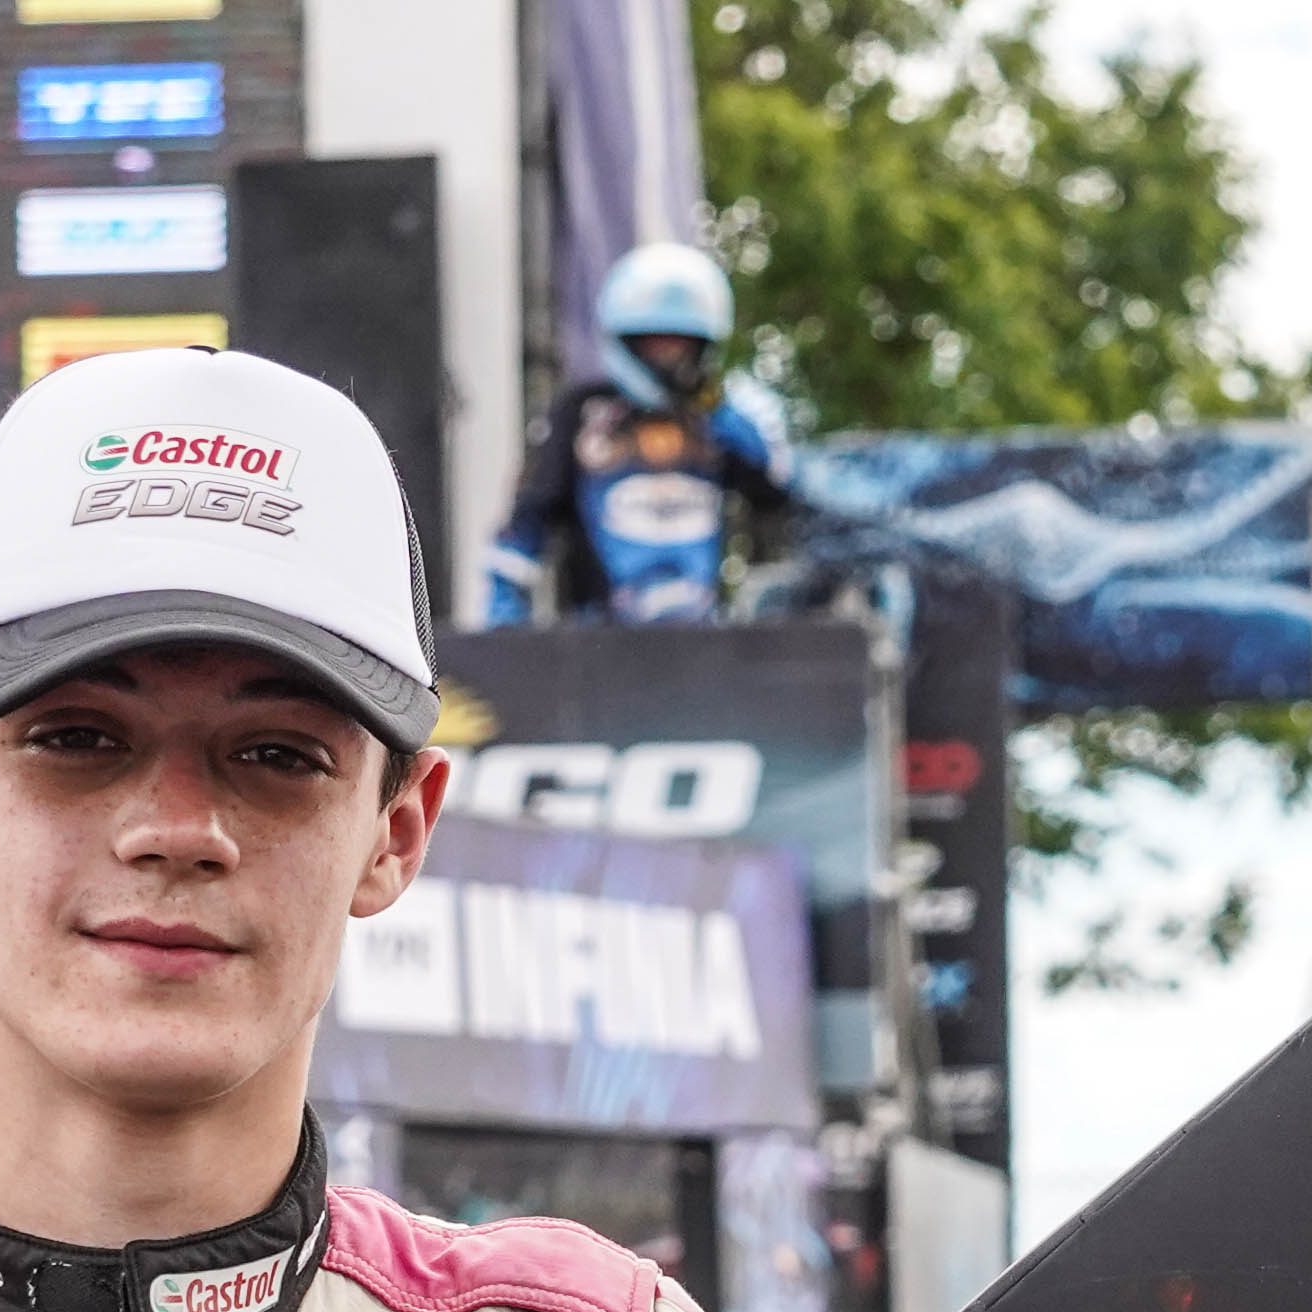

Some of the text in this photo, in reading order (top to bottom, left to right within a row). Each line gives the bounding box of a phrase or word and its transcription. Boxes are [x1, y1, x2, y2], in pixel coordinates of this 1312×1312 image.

[132, 431, 283, 481] Castrol
[71, 478, 303, 536] EDGE
[446, 742, 764, 837] GO
